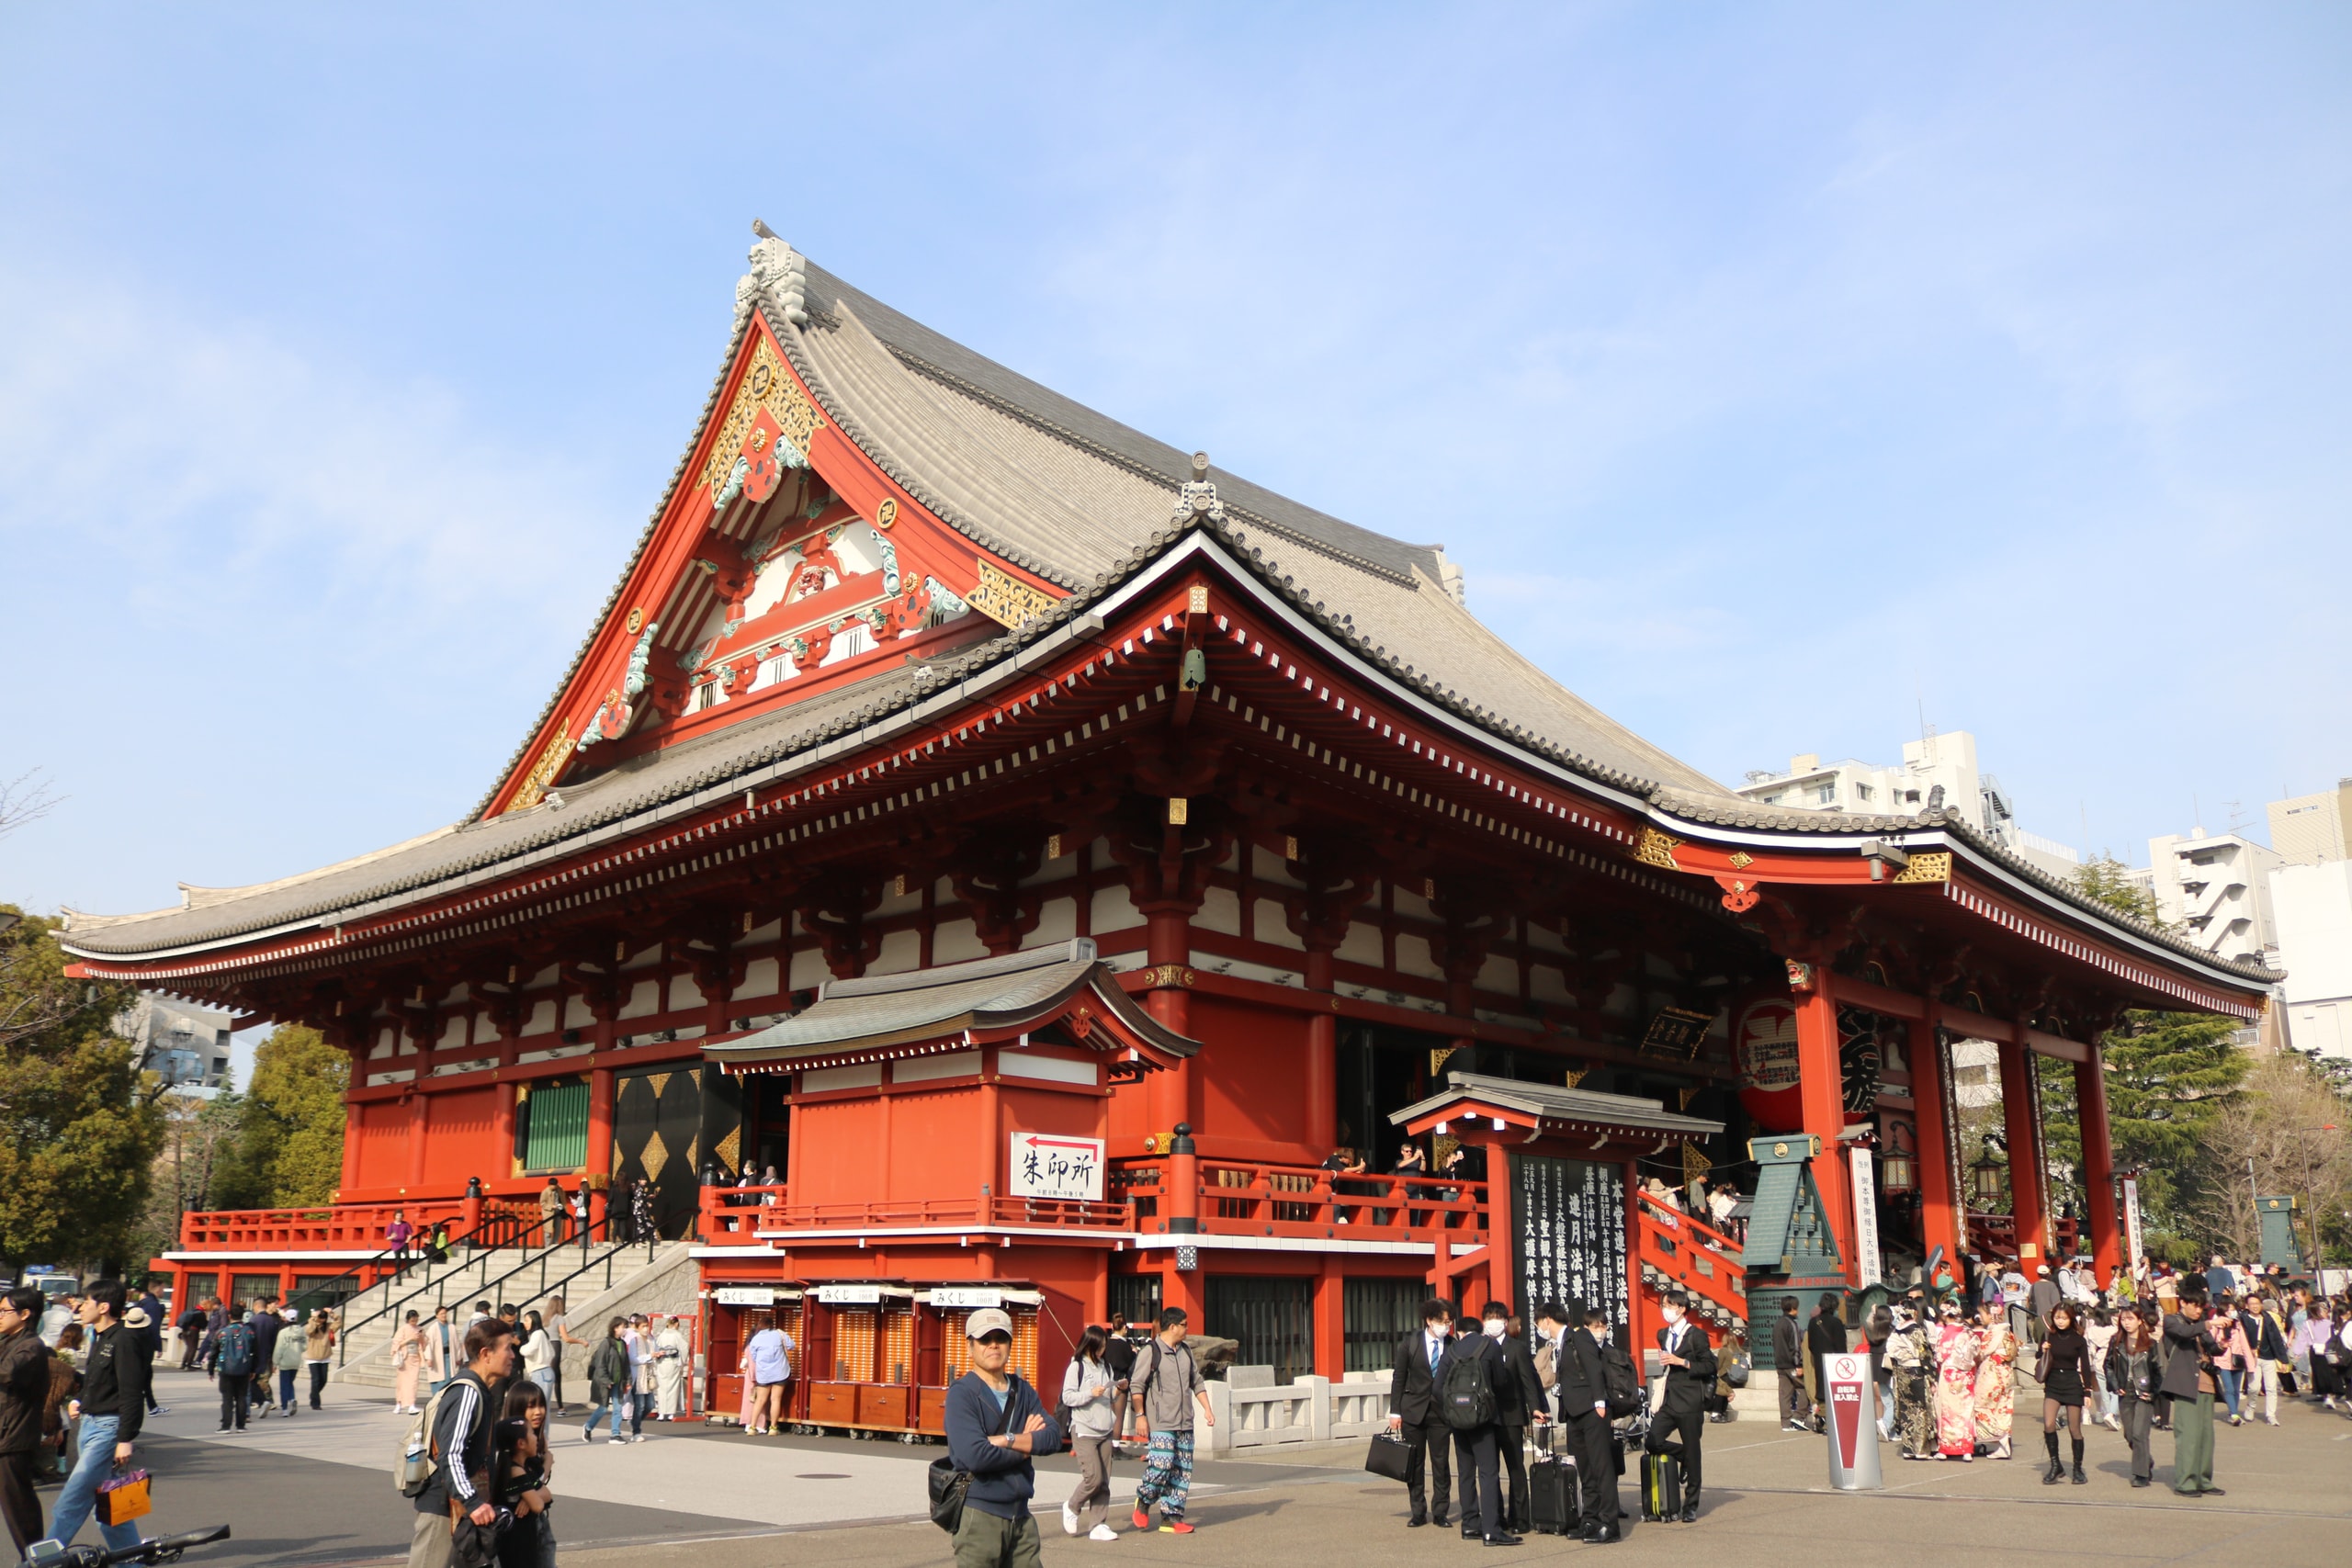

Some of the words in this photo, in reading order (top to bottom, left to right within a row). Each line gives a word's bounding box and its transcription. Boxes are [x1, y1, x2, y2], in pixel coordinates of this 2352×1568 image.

[1023, 1149, 1093, 1190] 朱印所
[825, 1289, 849, 1301] みくじ
[937, 1292, 966, 1304] みくじ
